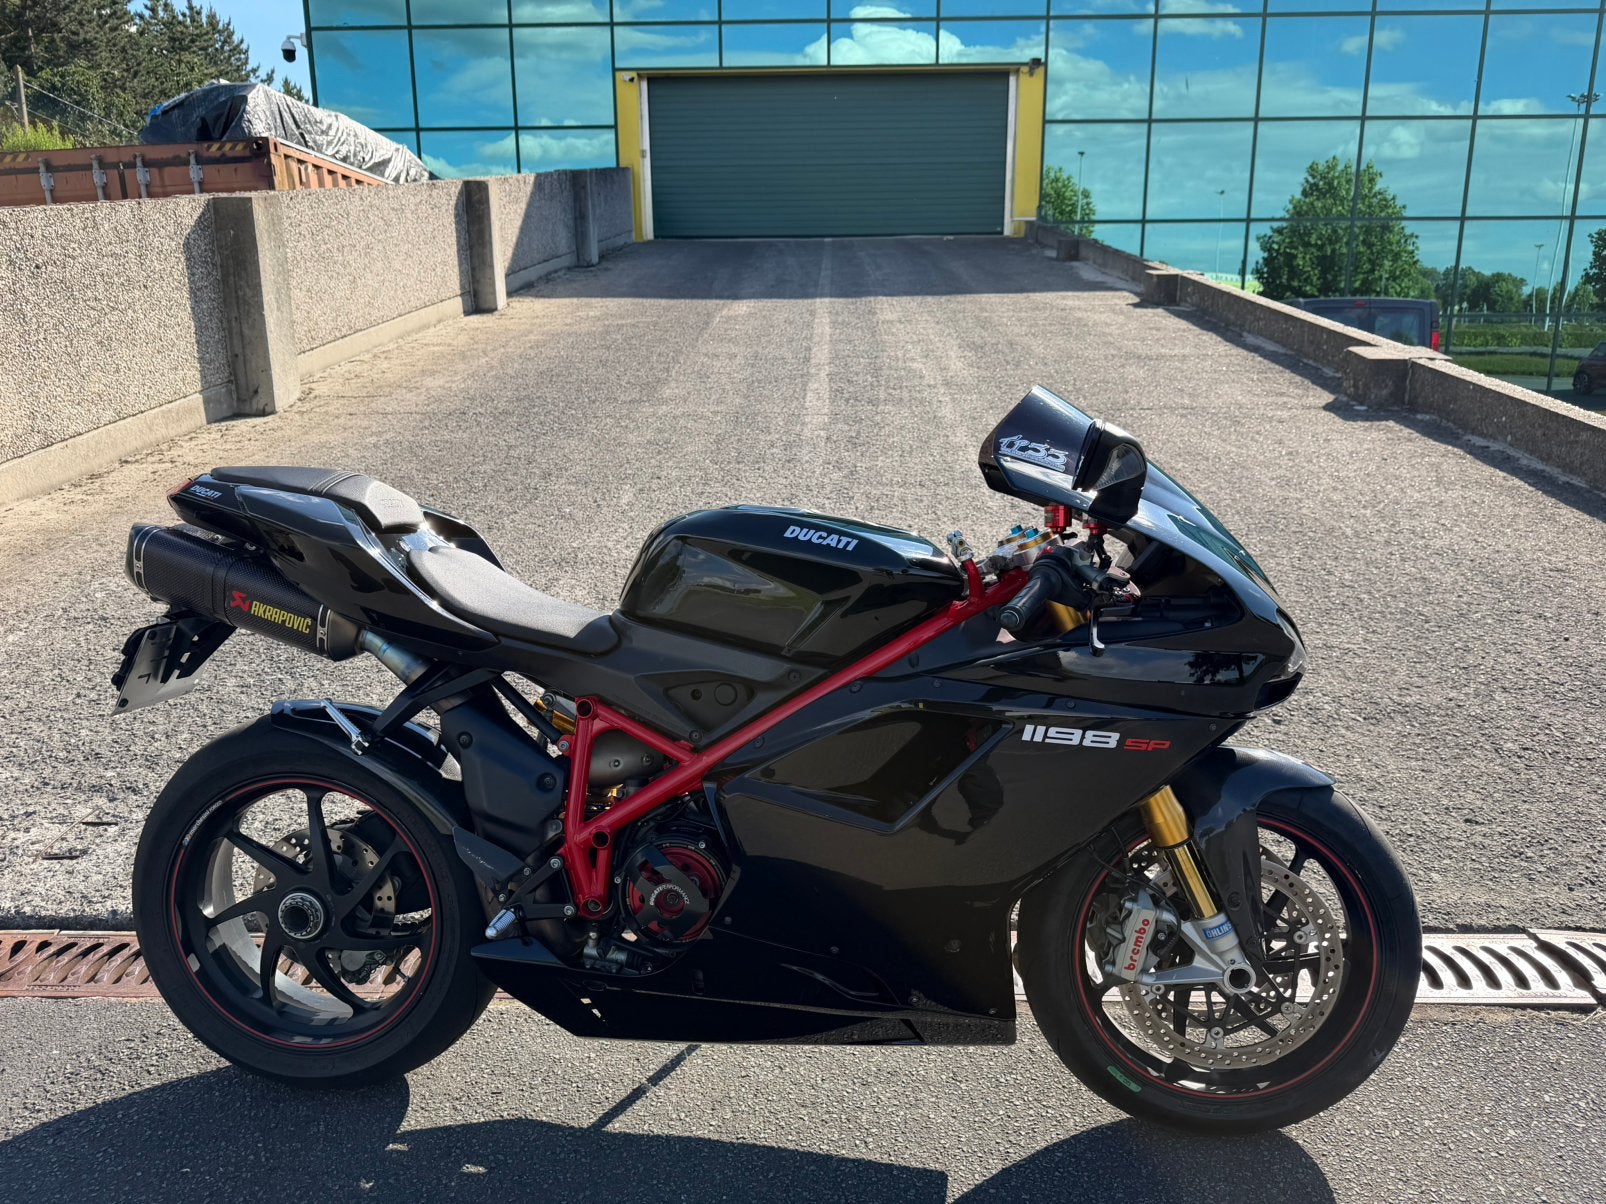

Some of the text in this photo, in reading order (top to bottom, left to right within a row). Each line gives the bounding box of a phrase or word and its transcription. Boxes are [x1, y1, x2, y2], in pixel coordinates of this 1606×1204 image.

[190, 485, 223, 499] DUCATI
[783, 525, 859, 551] DUCATI
[1021, 724, 1171, 752] 1198 SP
[1123, 918, 1150, 971] brembo
